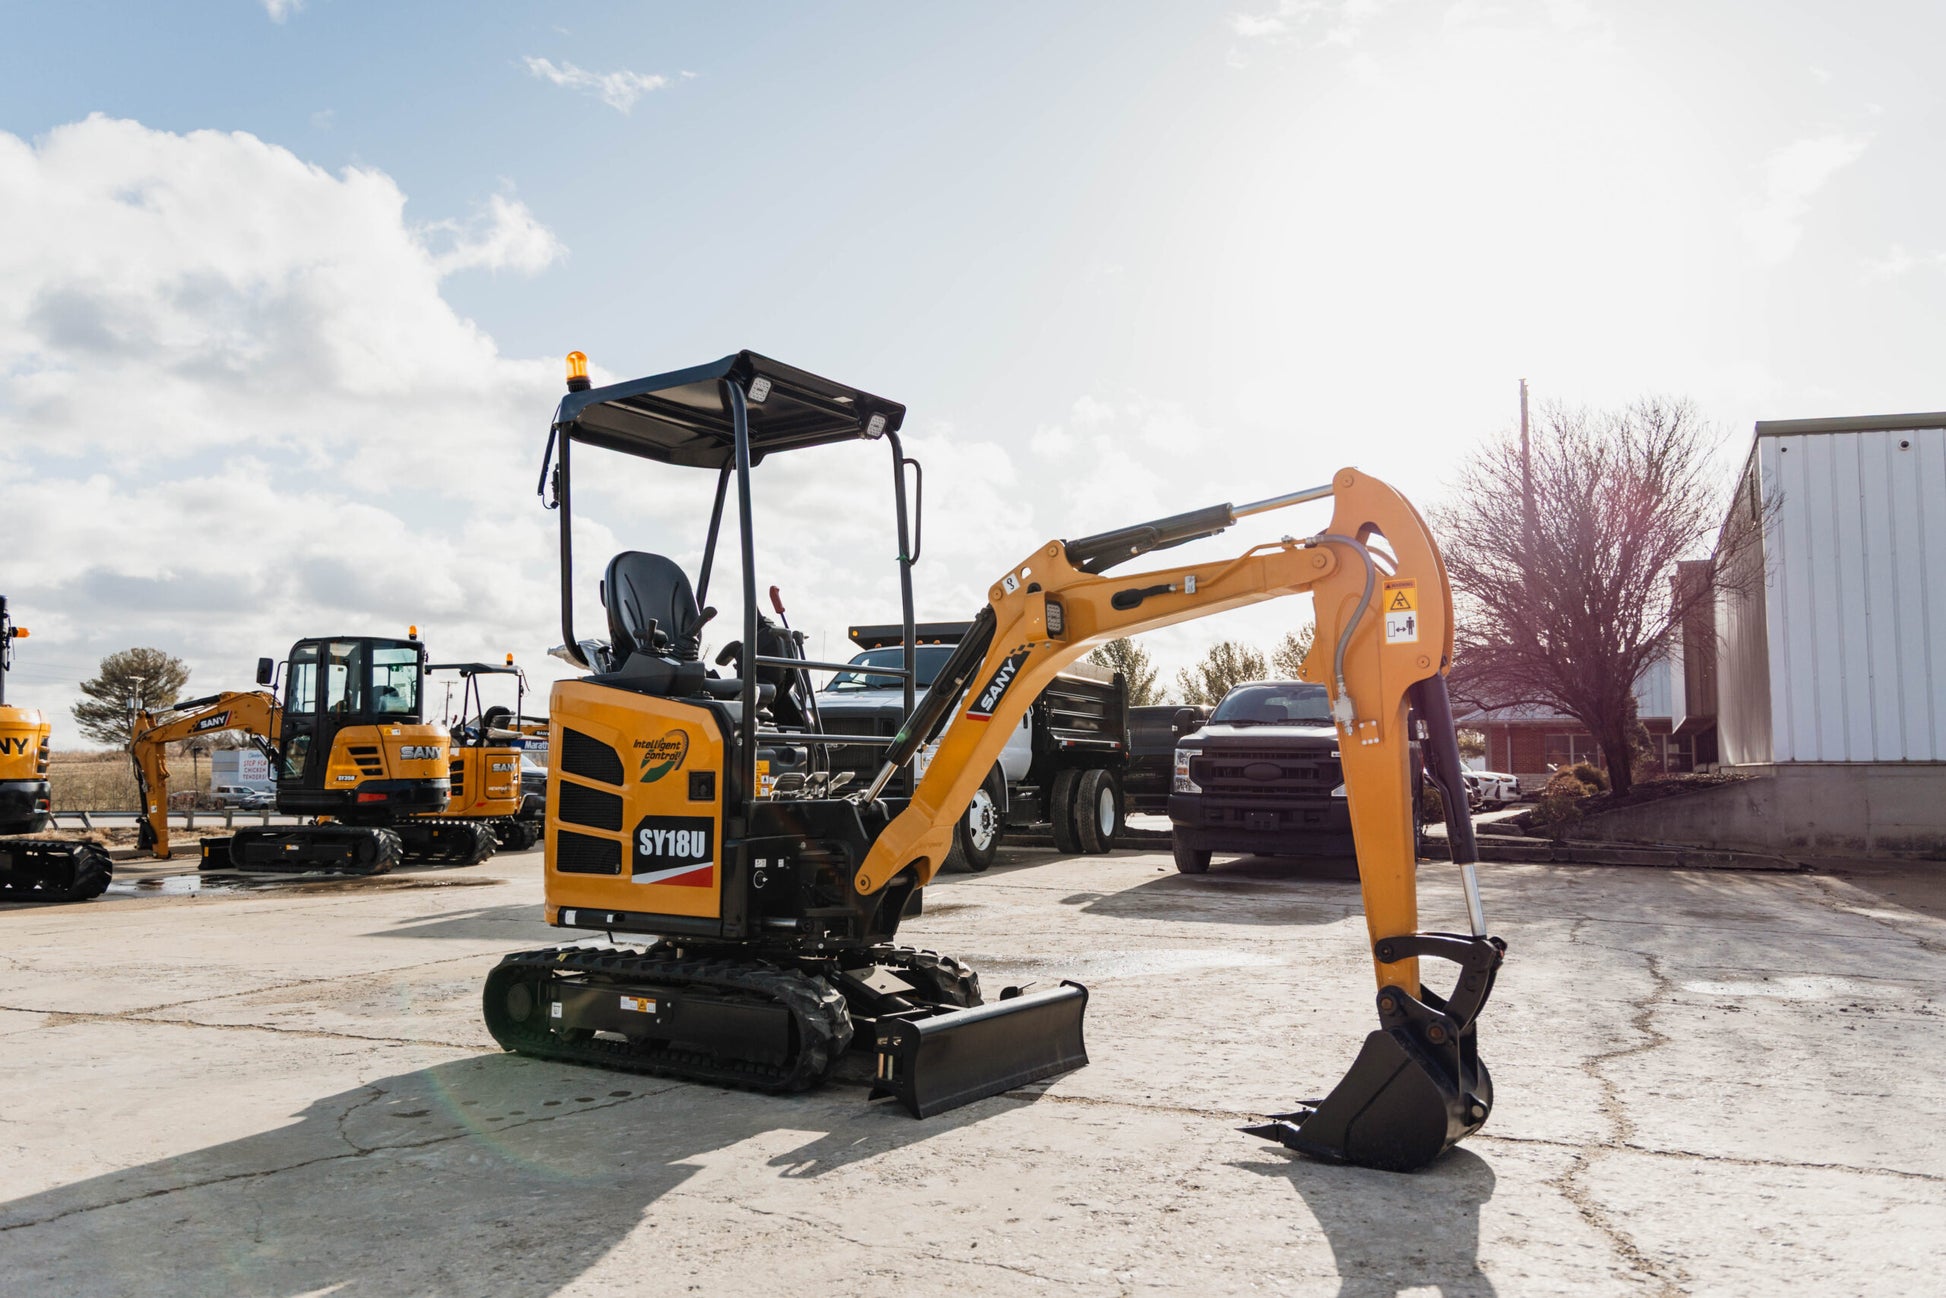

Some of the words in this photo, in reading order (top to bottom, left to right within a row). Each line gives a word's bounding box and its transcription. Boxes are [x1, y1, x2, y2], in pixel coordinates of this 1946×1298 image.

[981, 658, 1016, 712] SANY
[200, 716, 225, 729] SANY
[633, 738, 681, 752] Intelligent
[401, 746, 441, 760] SANY
[645, 751, 681, 760] control
[640, 828, 706, 858] SY18U
